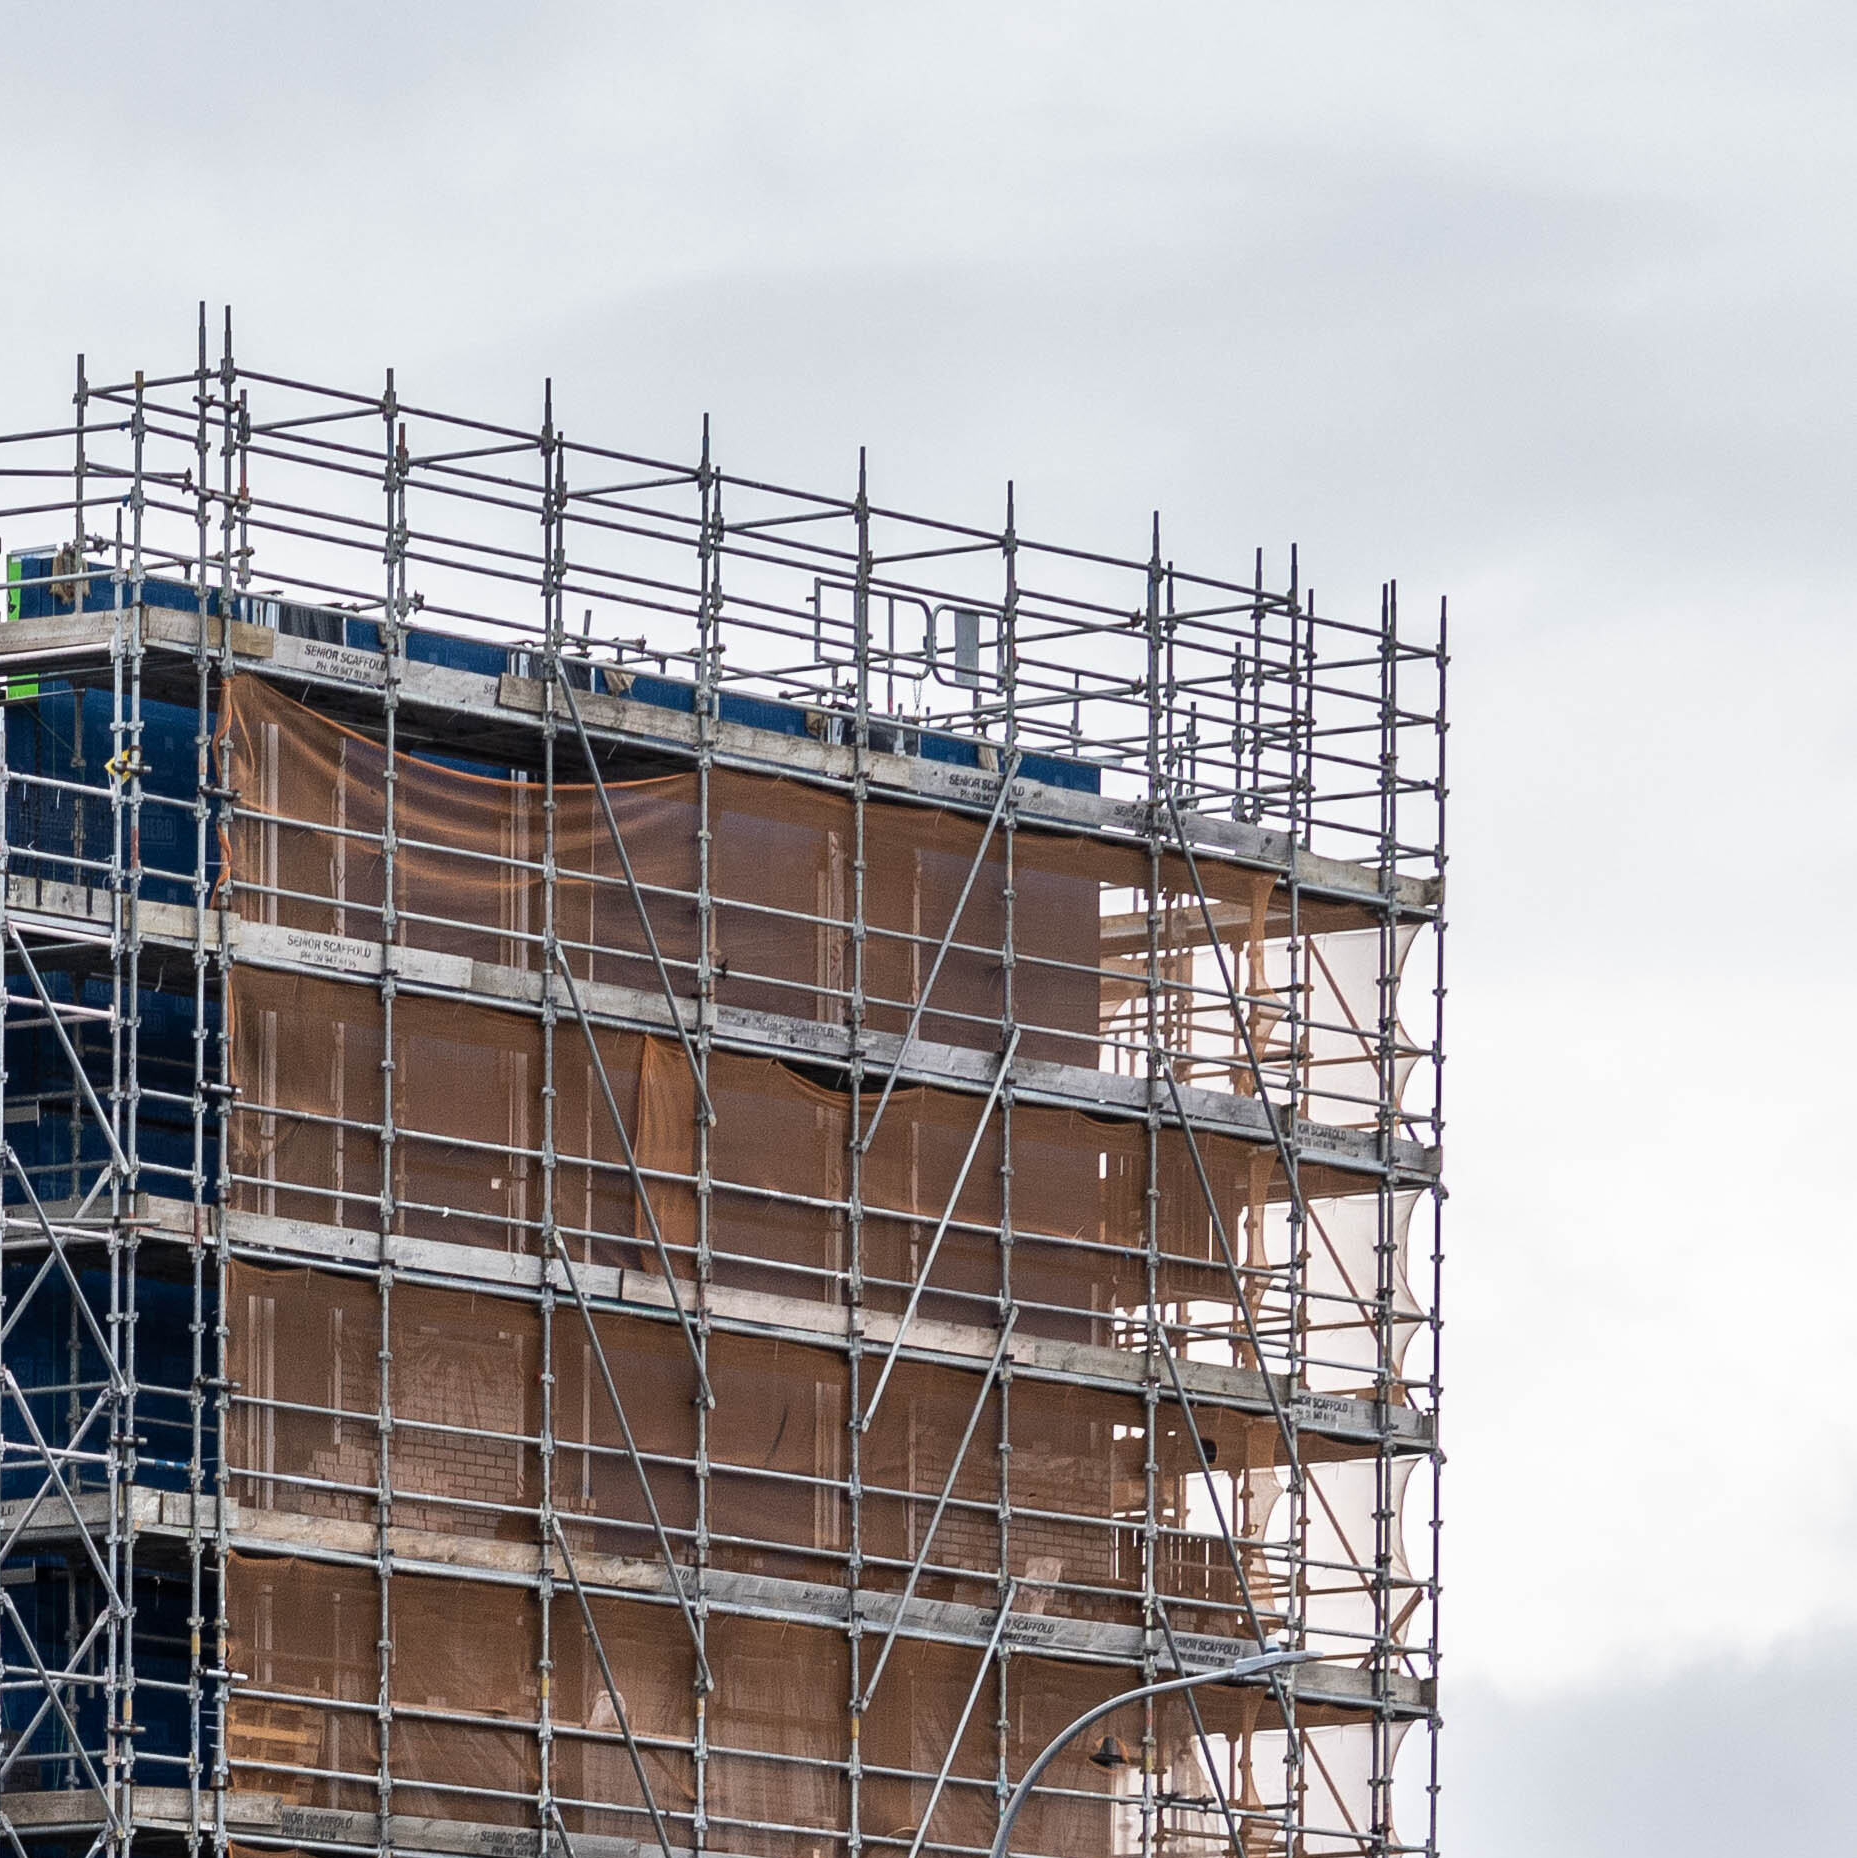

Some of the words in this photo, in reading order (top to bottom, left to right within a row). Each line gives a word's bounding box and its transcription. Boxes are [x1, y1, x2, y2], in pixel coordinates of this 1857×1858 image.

[305, 643, 339, 663] SENIOR
[340, 652, 388, 673] SCAFFOLD
[949, 773, 982, 790] SENIOR
[982, 779, 1026, 798] SCALD
[287, 934, 322, 951] SENIOR
[323, 940, 372, 959] SCAFFOLD
[1013, 1618, 1055, 1635] SCAFFOLD
[1198, 1640, 1241, 1657] SCAFFOLD
